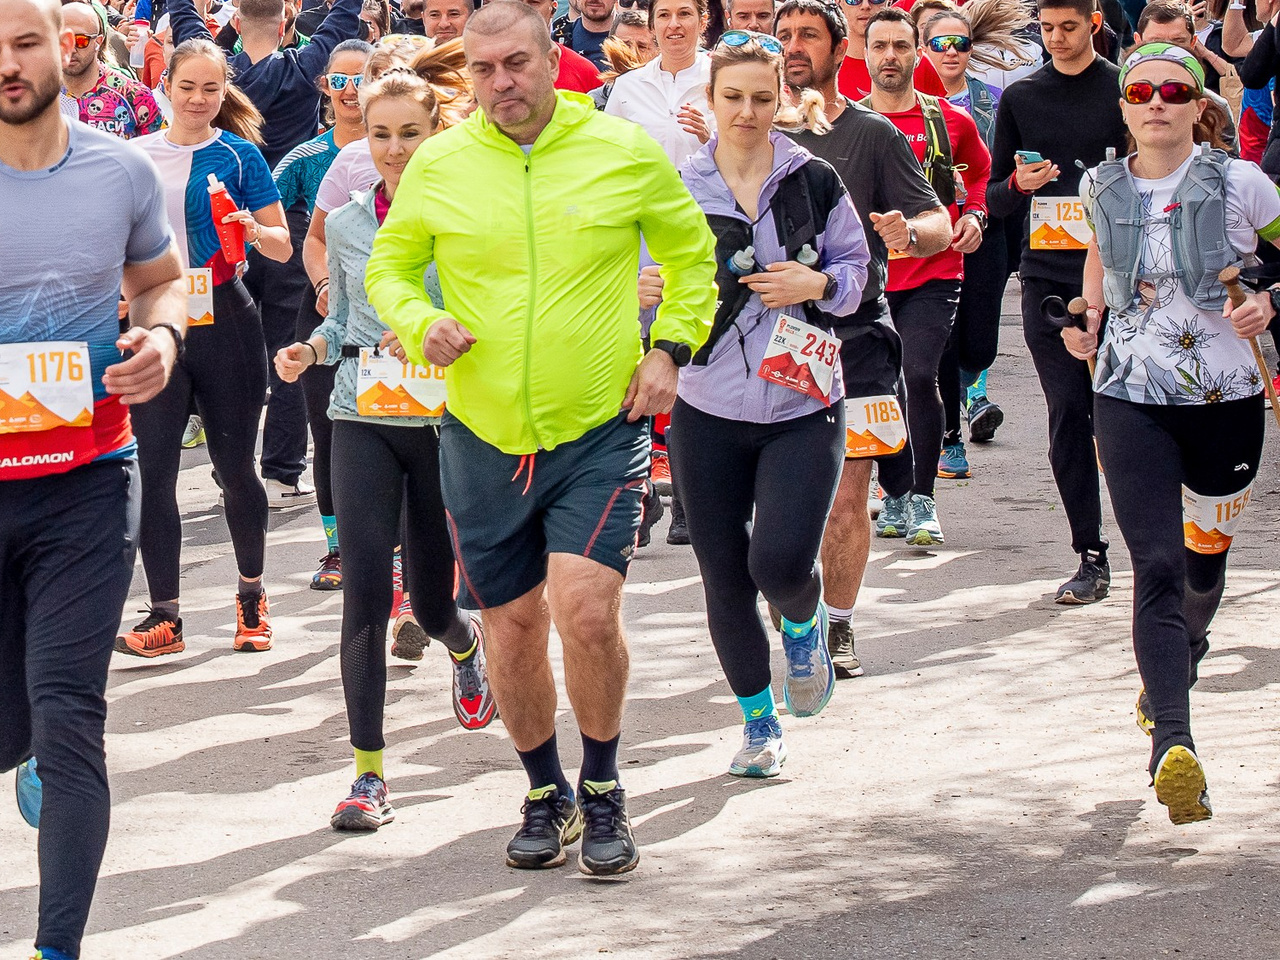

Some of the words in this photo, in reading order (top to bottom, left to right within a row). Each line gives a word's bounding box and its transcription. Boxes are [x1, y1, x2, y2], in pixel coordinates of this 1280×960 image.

[773, 334, 787, 345] 22K
[800, 332, 837, 367] 243
[26, 351, 84, 383] 1176
[863, 401, 900, 424] 1185
